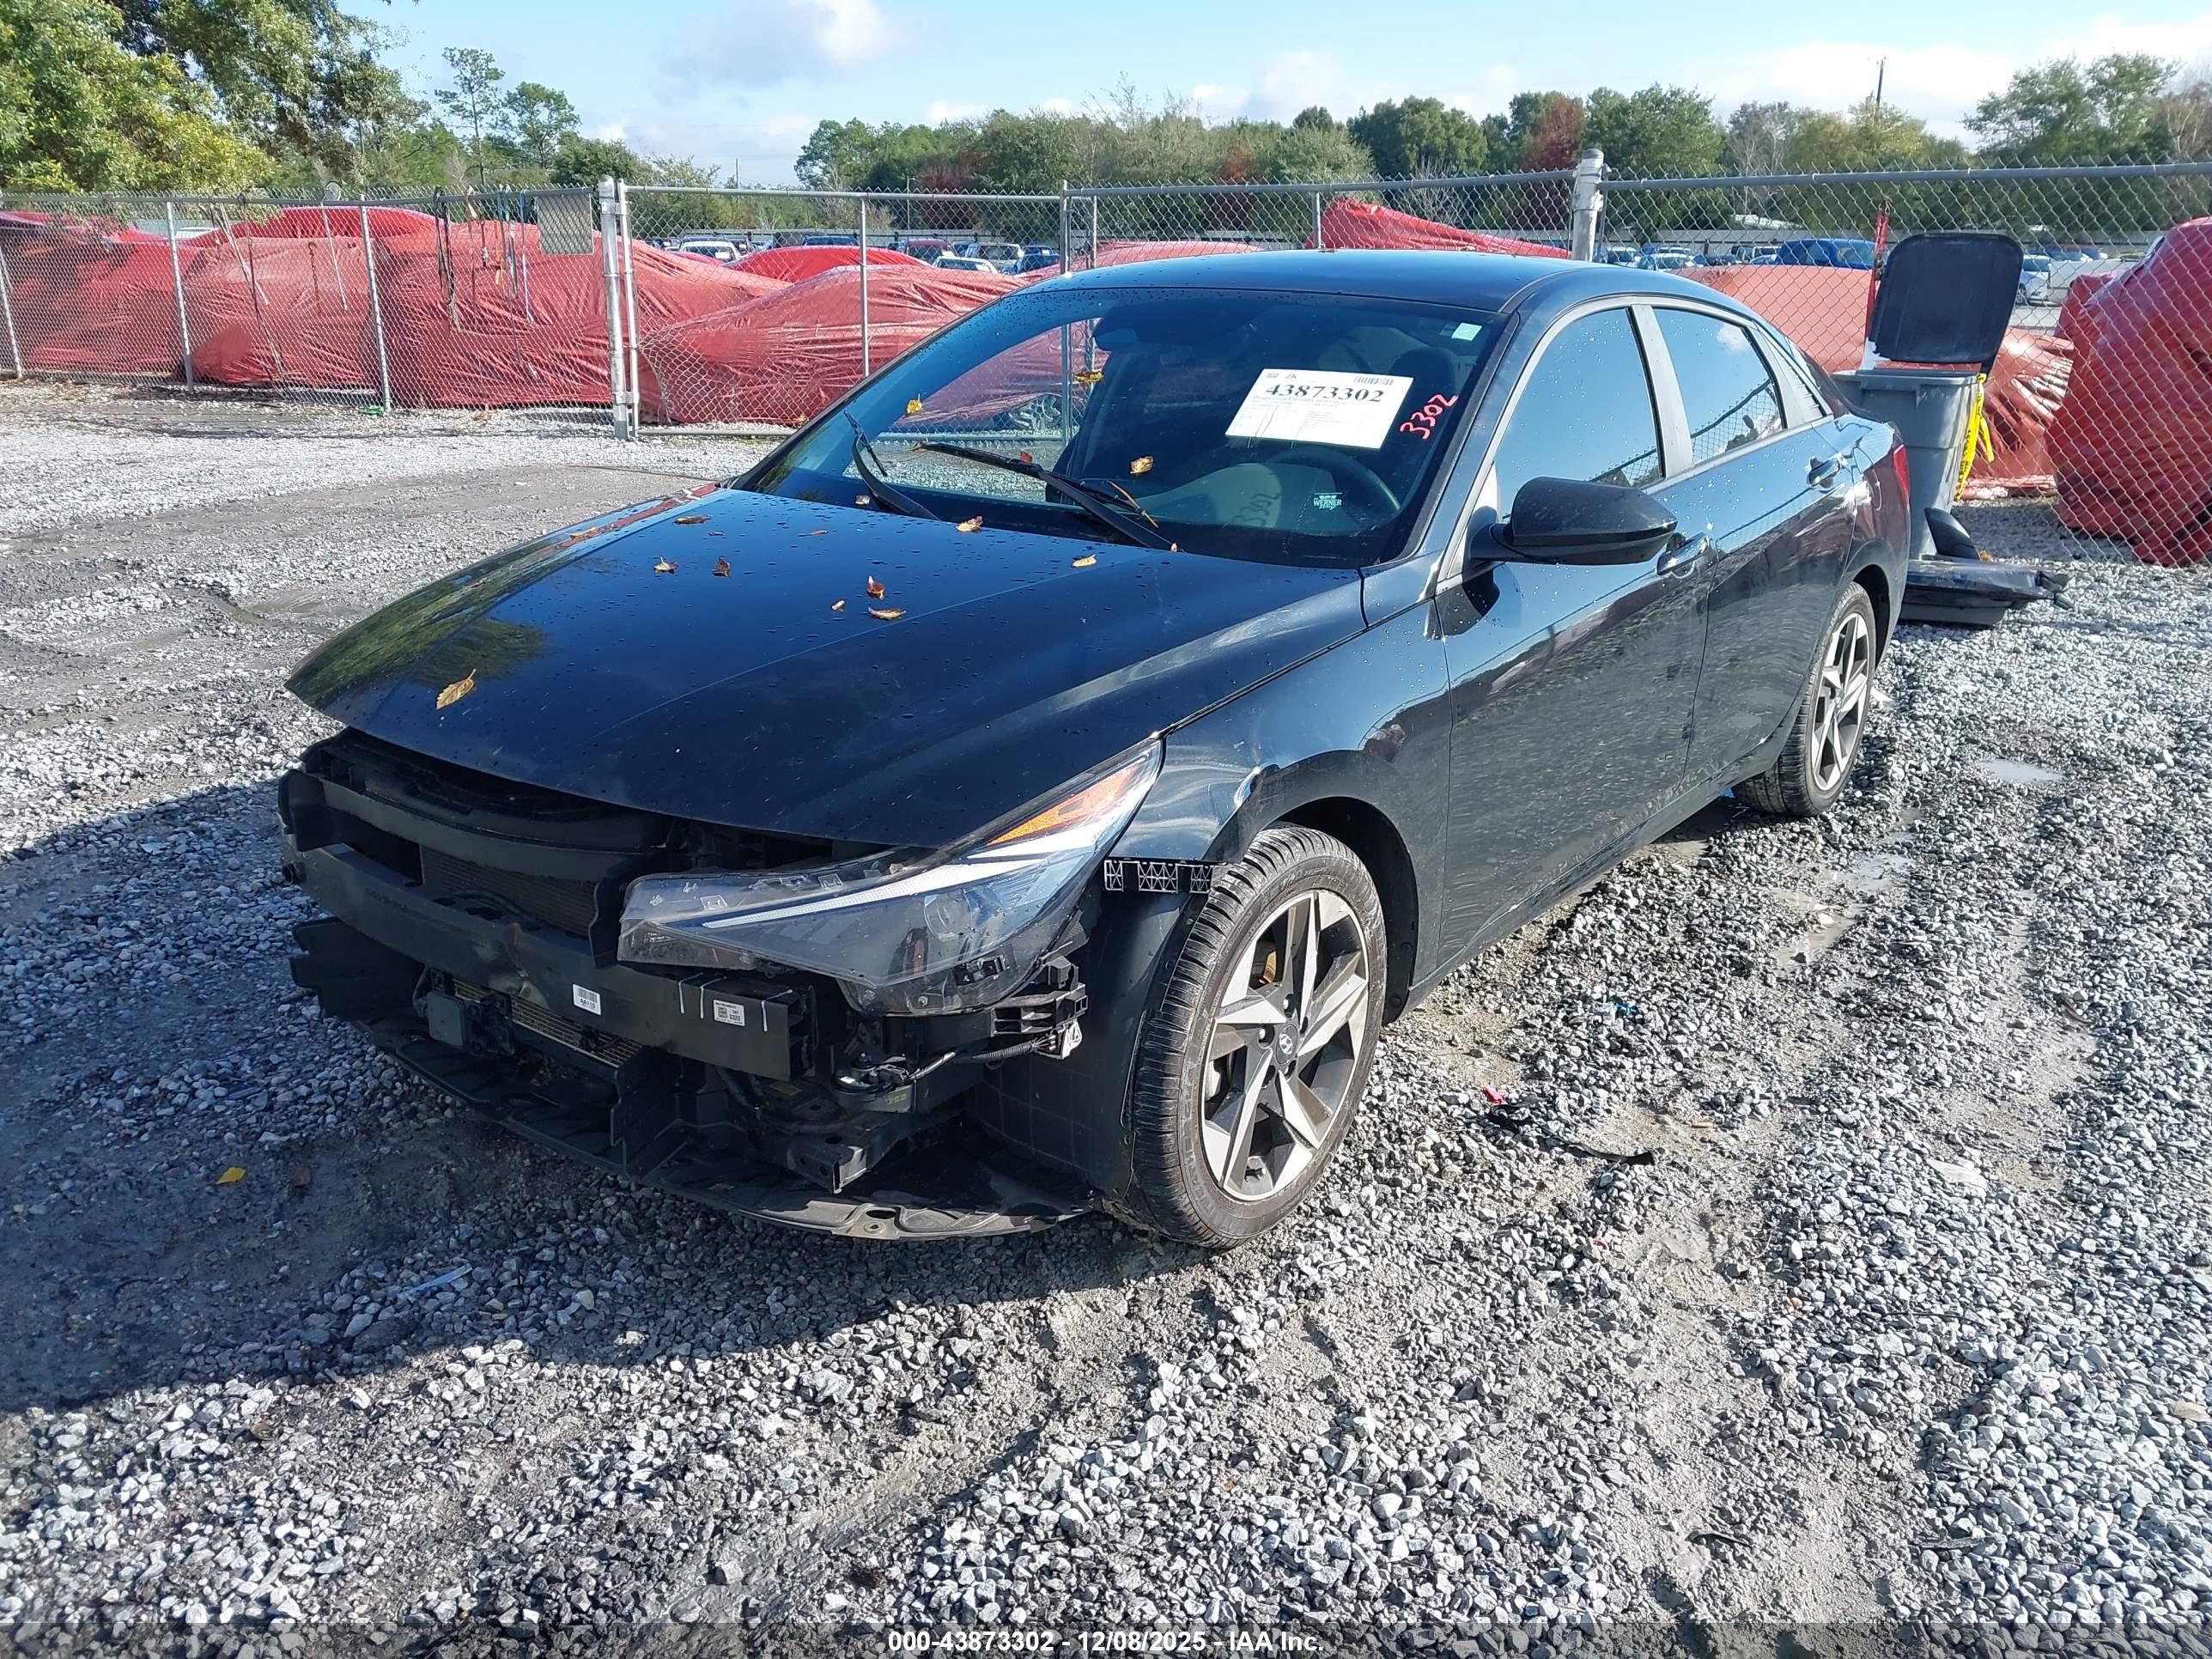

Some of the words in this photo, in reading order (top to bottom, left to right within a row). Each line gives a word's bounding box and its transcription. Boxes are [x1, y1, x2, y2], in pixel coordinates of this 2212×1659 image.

[1266, 384, 1384, 403] 43873302
[1400, 394, 1459, 440] 3302
[1313, 497, 1342, 506] WERNER
